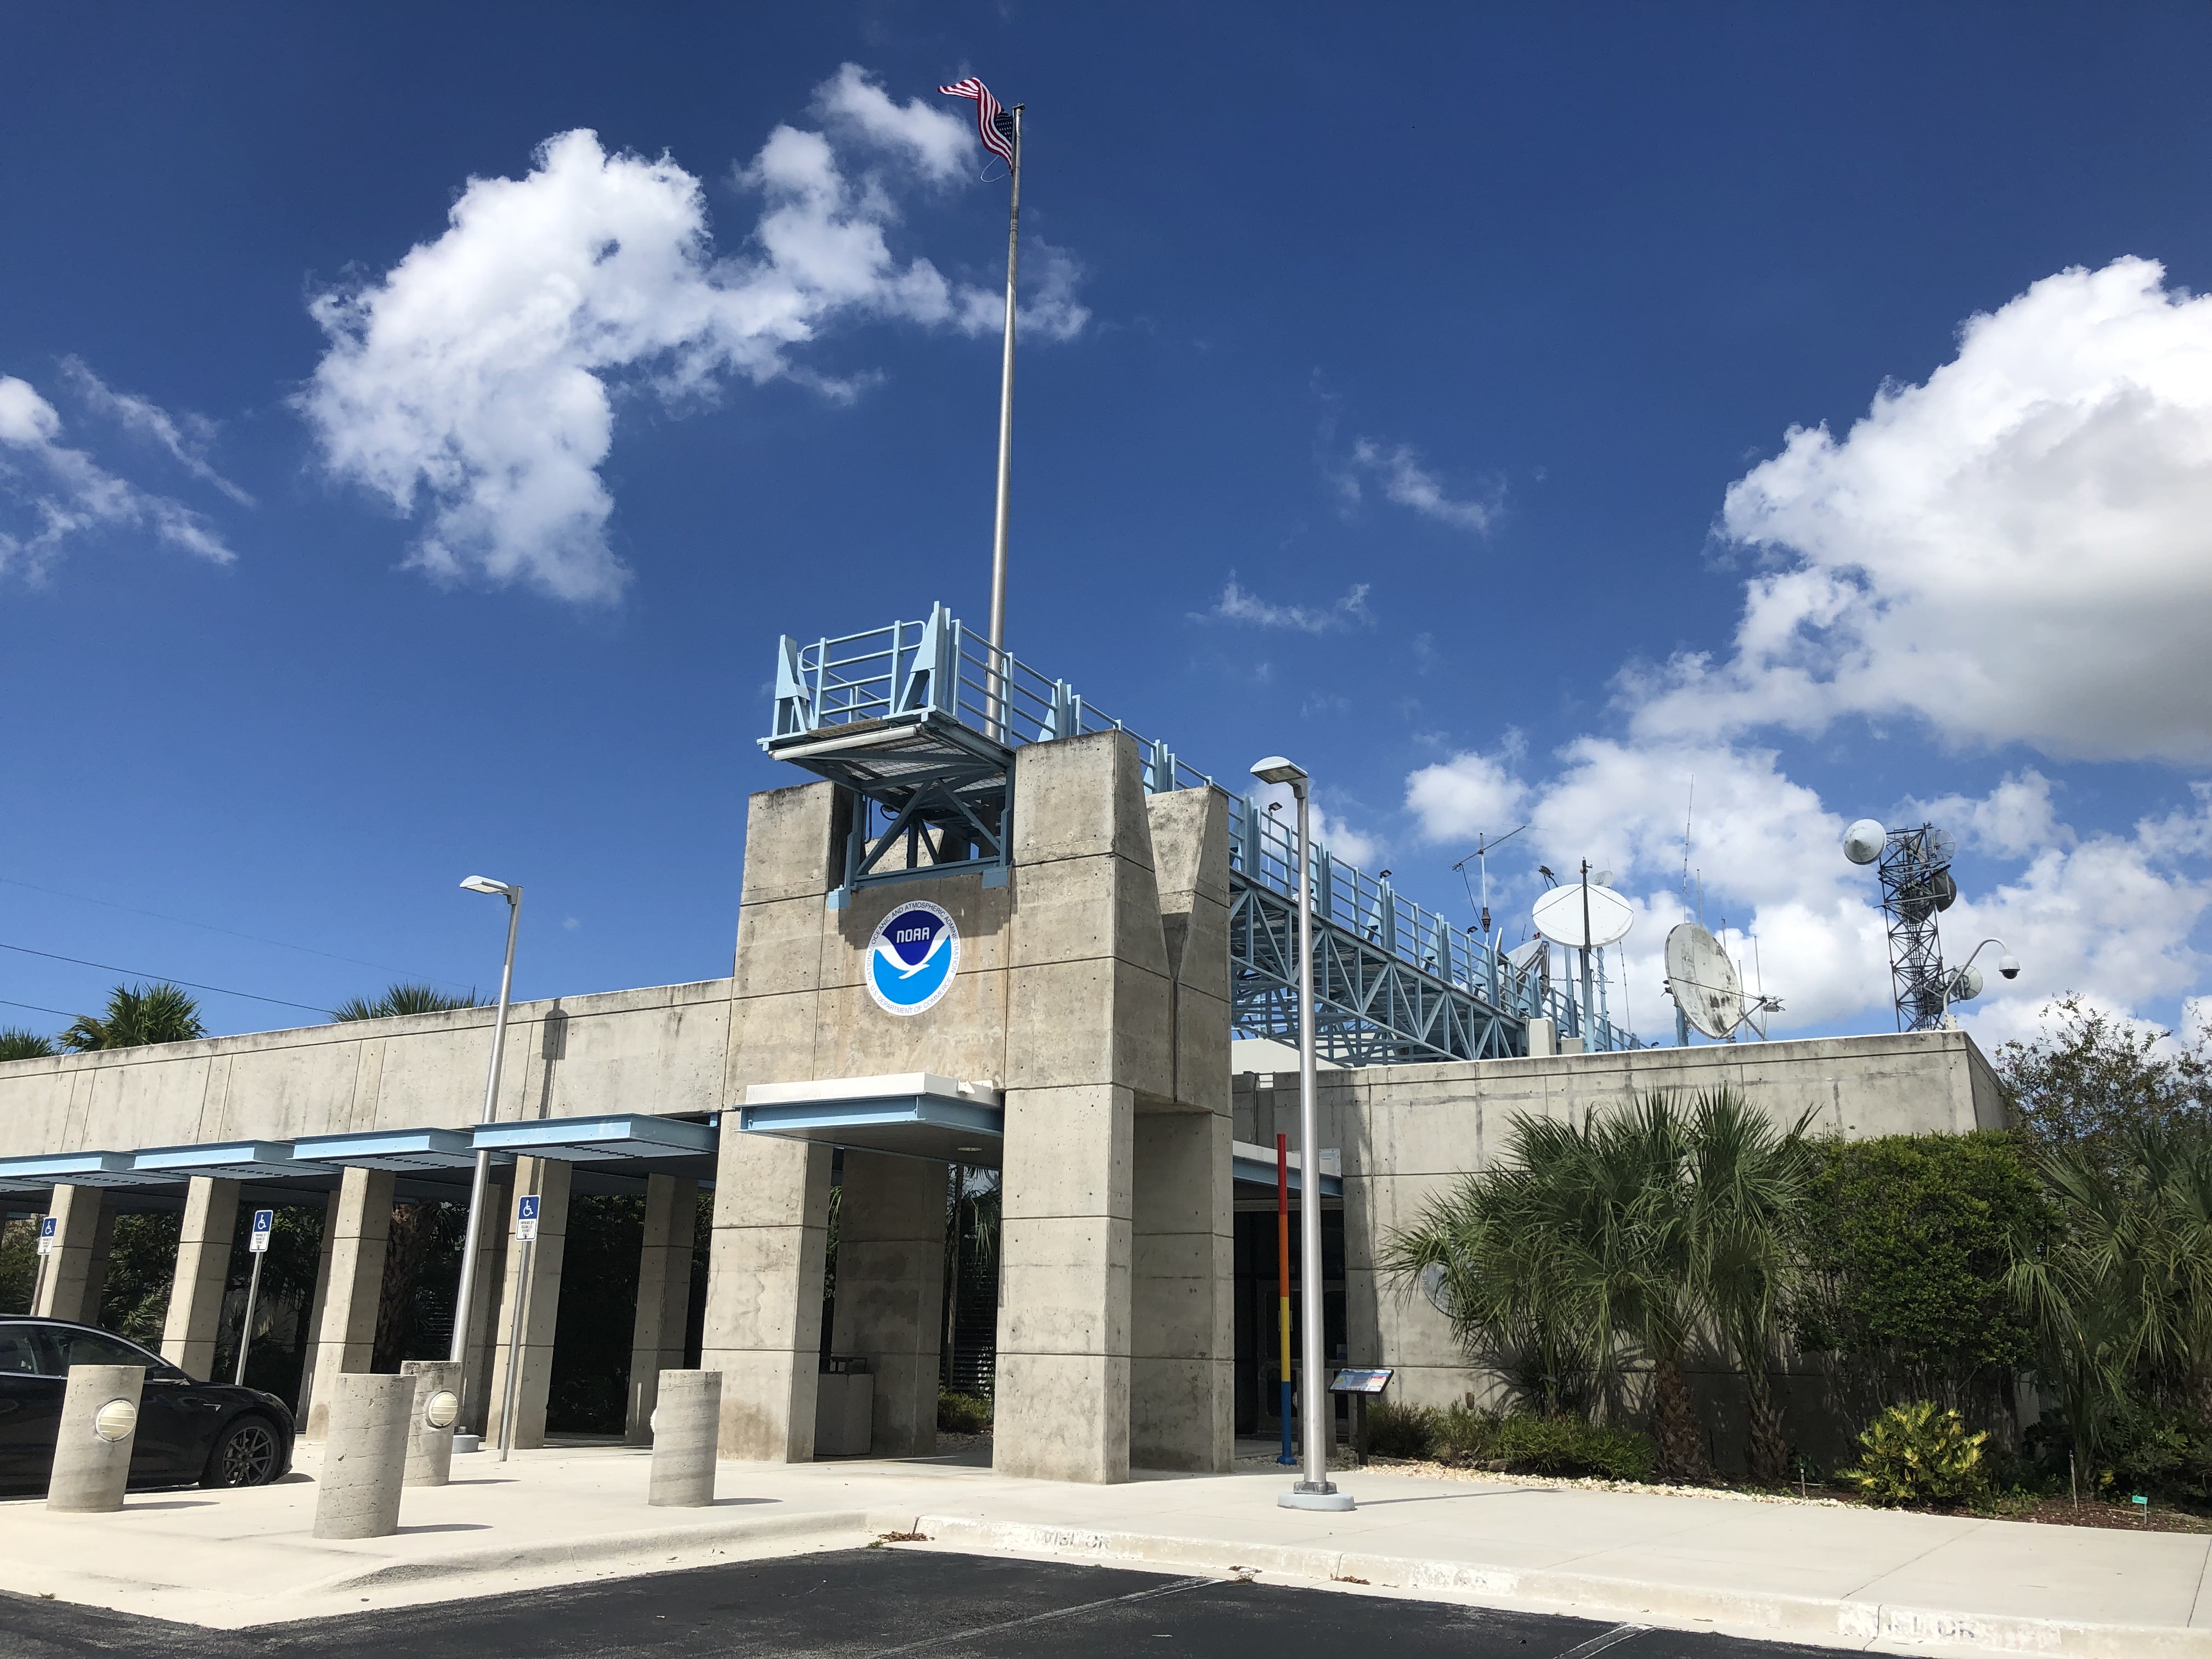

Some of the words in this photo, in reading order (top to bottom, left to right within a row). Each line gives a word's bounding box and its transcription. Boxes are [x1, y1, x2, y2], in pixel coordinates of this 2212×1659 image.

[867, 946, 875, 981] NATIONAL
[872, 916, 891, 944] OCEANIC
[891, 907, 904, 918] AND
[905, 902, 945, 917] ATMOSPHERIC
[944, 916, 959, 973] ADMINISTRATION
[896, 927, 930, 943] NOAA
[877, 996, 913, 1014] DEPARTMENT
[923, 978, 952, 1008] COMMERCE
[1044, 1531, 1109, 1549] VISIOR
